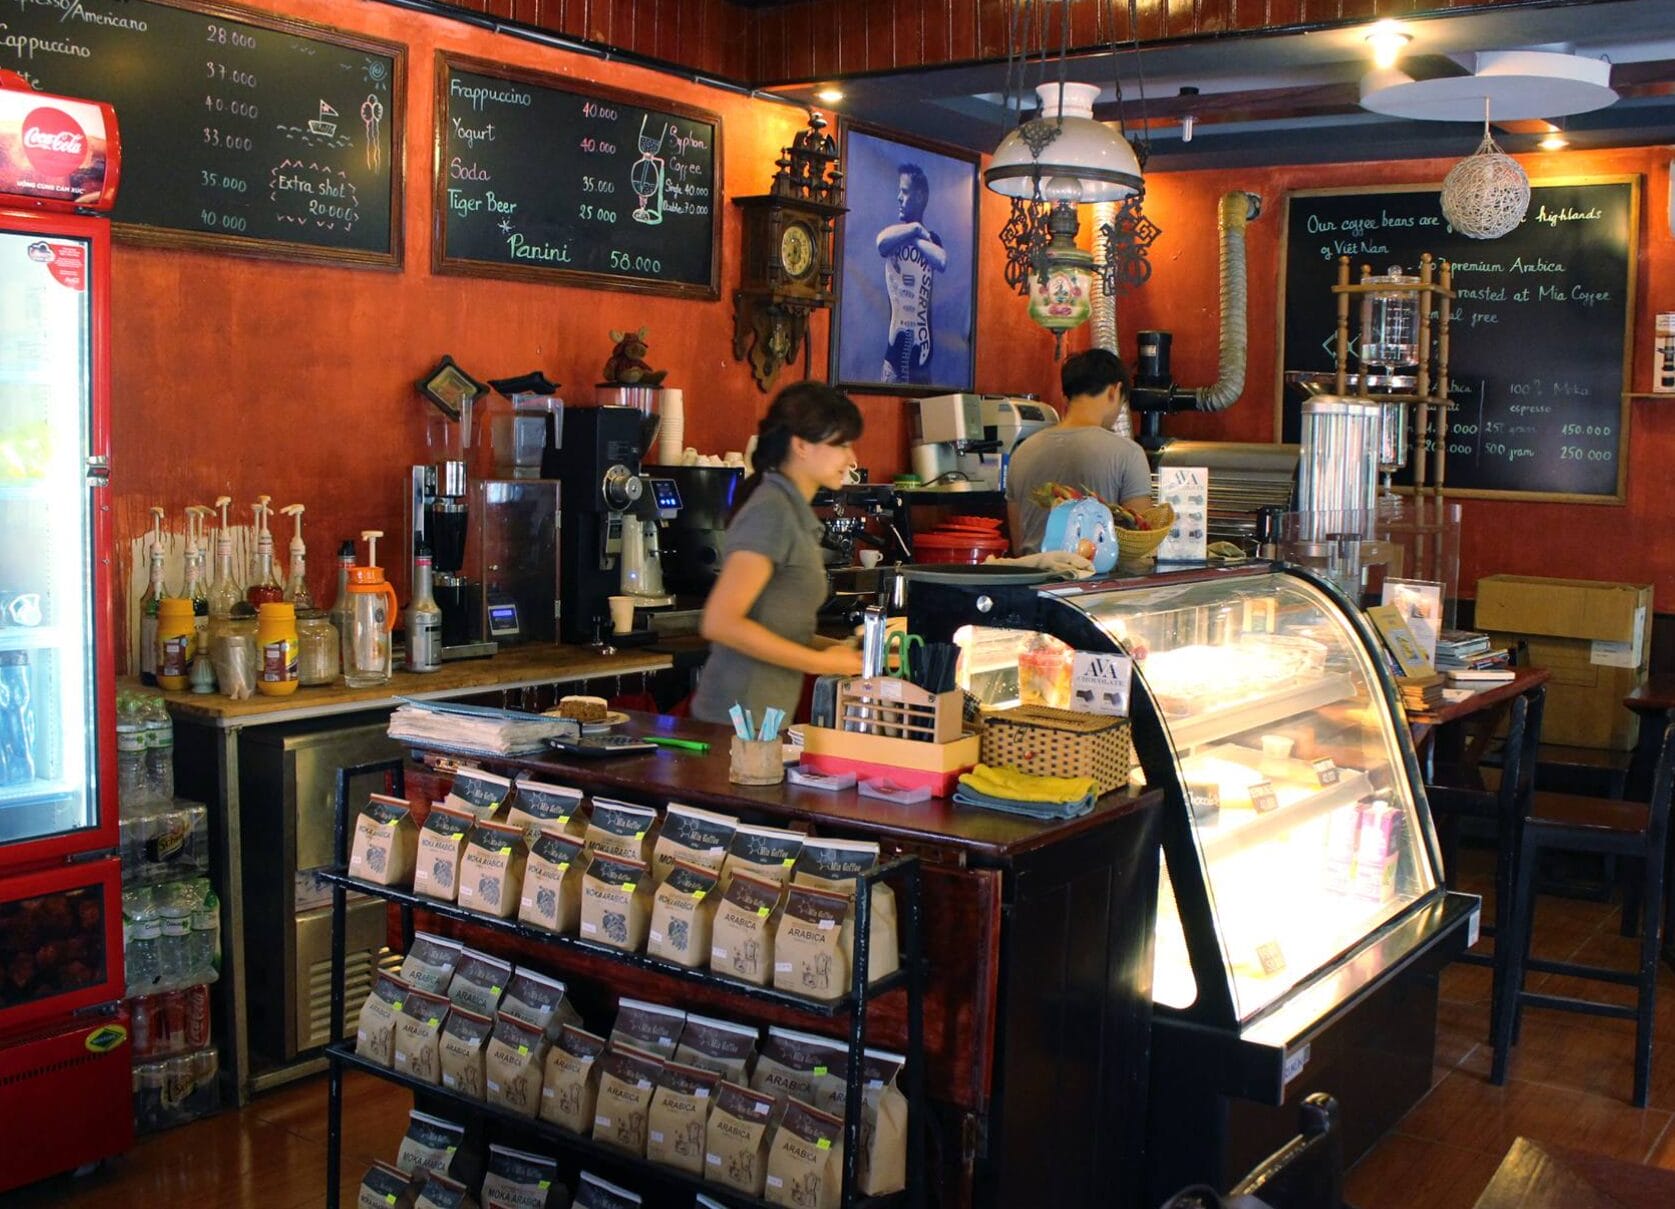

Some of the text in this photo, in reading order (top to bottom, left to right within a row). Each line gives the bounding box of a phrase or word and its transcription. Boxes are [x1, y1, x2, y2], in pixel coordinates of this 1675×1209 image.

[206, 61, 257, 87] 37.000
[205, 95, 259, 119] 40.000
[450, 79, 618, 121] Frappuccino 40.000
[23, 127, 84, 154] Coca-Cola
[203, 127, 252, 151] 33.000
[453, 117, 616, 155] Yogurt 40.000
[669, 125, 708, 157] Syphon
[200, 169, 247, 192] 35.000
[450, 158, 615, 194] Soda 35.000
[669, 156, 702, 181] Coffee
[278, 175, 346, 198] Extra shot
[447, 188, 483, 218] Tiger
[486, 191, 517, 214] Beer
[1307, 214, 1337, 234] Our
[1381, 210, 1415, 228] beans
[1419, 216, 1440, 226] are
[1535, 205, 1603, 227] highlands
[507, 233, 661, 273] Panini 58.000
[1360, 242, 1390, 253] Nam
[1451, 260, 1503, 278] premium
[1509, 257, 1566, 273] Arabica
[1458, 285, 1506, 301] roasted
[1513, 289, 1529, 302] at
[1539, 286, 1567, 301] Mia
[724, 914, 757, 930] ARABICA
[788, 927, 826, 943] ARABICA
[607, 1086, 640, 1103] ARABICA
[663, 1098, 696, 1113] ARABICA
[717, 1121, 751, 1140] ARABICA
[783, 1142, 817, 1163] ARABICA
